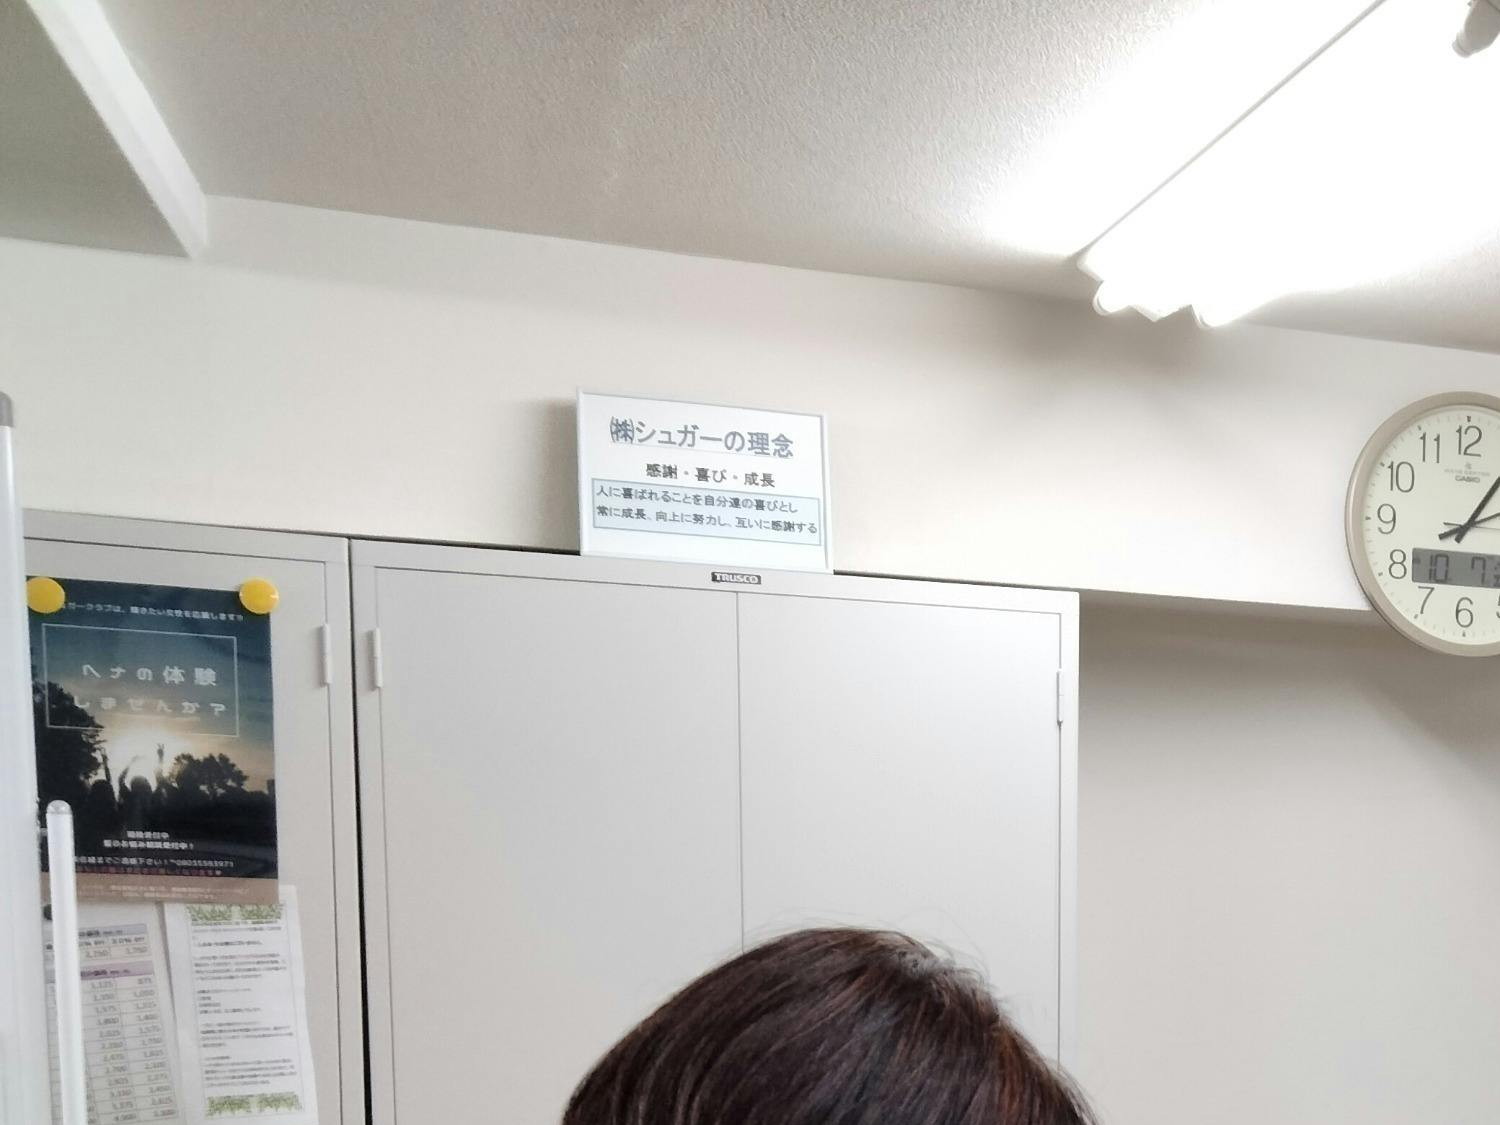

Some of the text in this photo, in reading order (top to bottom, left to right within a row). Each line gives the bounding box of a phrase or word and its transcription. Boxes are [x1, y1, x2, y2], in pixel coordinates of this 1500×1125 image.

[610, 416, 794, 459] ㈱シュガーの理念
[1419, 432, 1441, 464] 11
[1455, 424, 1483, 458] 12
[645, 463, 776, 488] 感謝・喜び・成長
[1387, 460, 1415, 494] 10
[1377, 503, 1397, 535] 9
[714, 572, 759, 584] TRUSCO
[1388, 548, 1407, 580] 8
[1417, 585, 1435, 615] 7
[1454, 596, 1474, 629] 6
[80, 663, 218, 687] ヘナの体験
